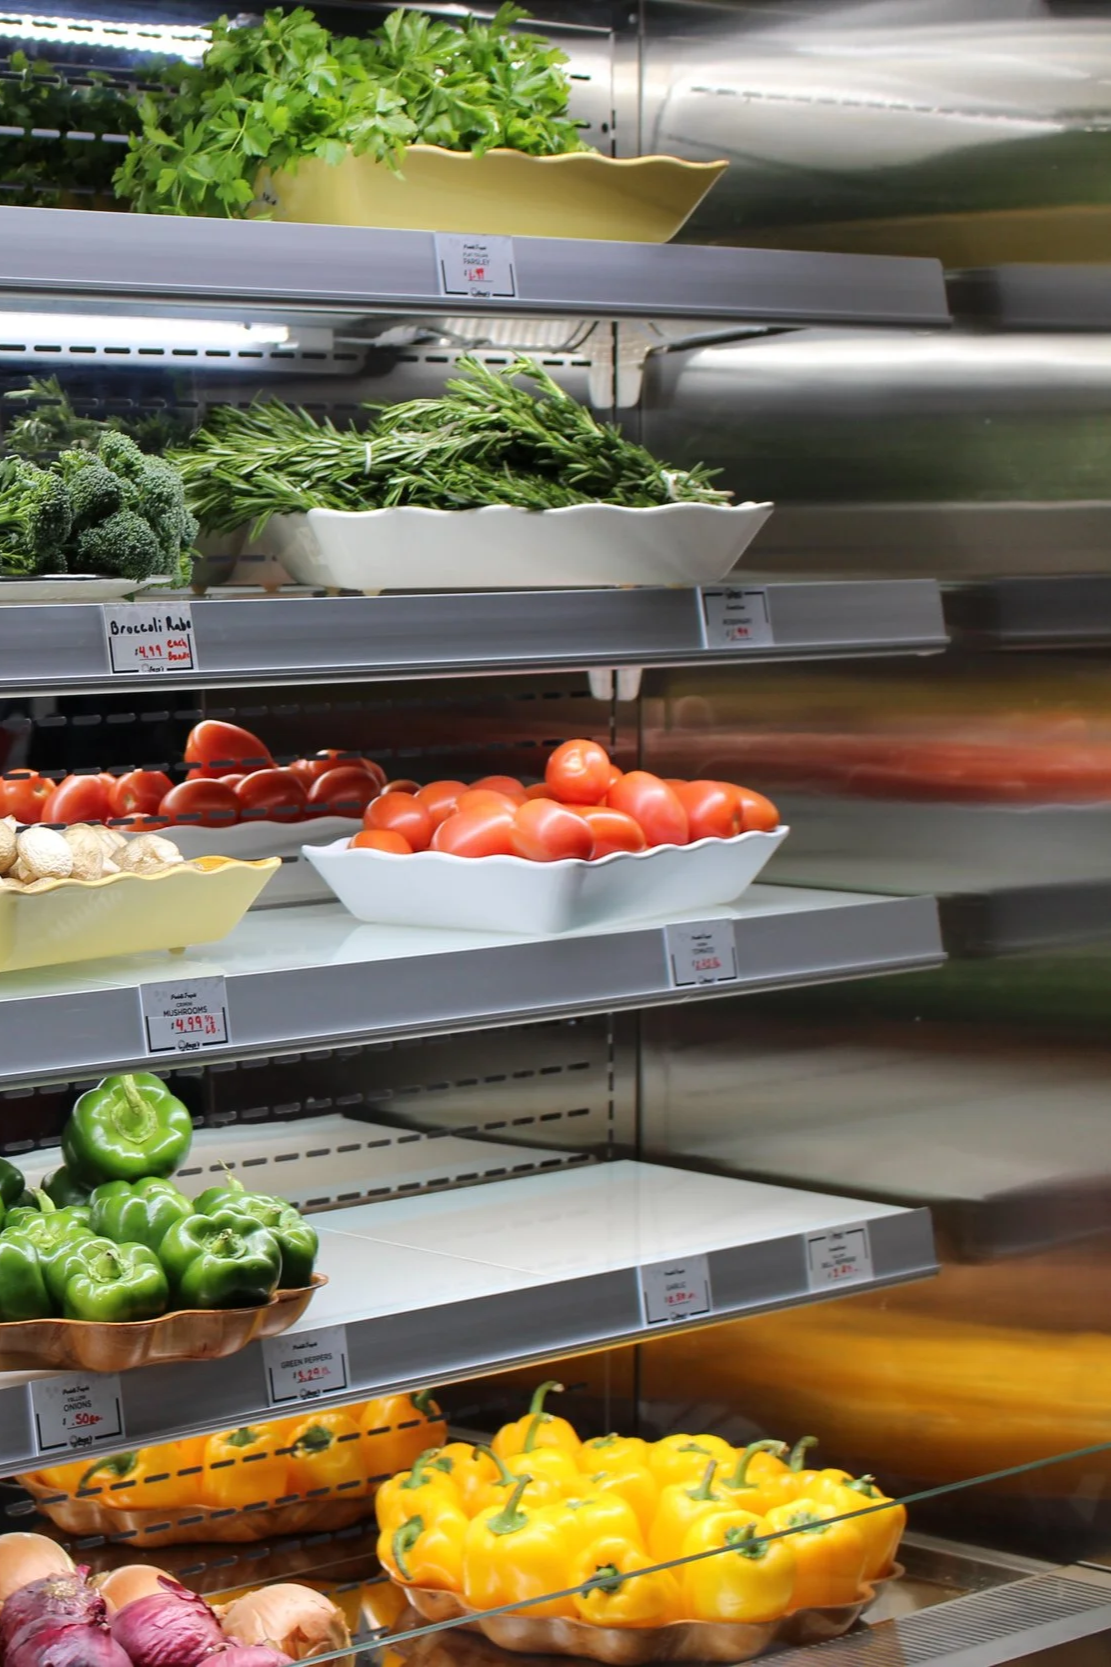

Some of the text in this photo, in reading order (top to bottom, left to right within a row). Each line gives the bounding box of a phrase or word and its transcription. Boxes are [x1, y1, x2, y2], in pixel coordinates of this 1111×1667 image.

[110, 617, 163, 635] Broccoli
[163, 1005, 208, 1017] MUSHROOMS
[281, 1353, 333, 1369] GREEN PEPPERS
[64, 1400, 92, 1412] ONIONS
